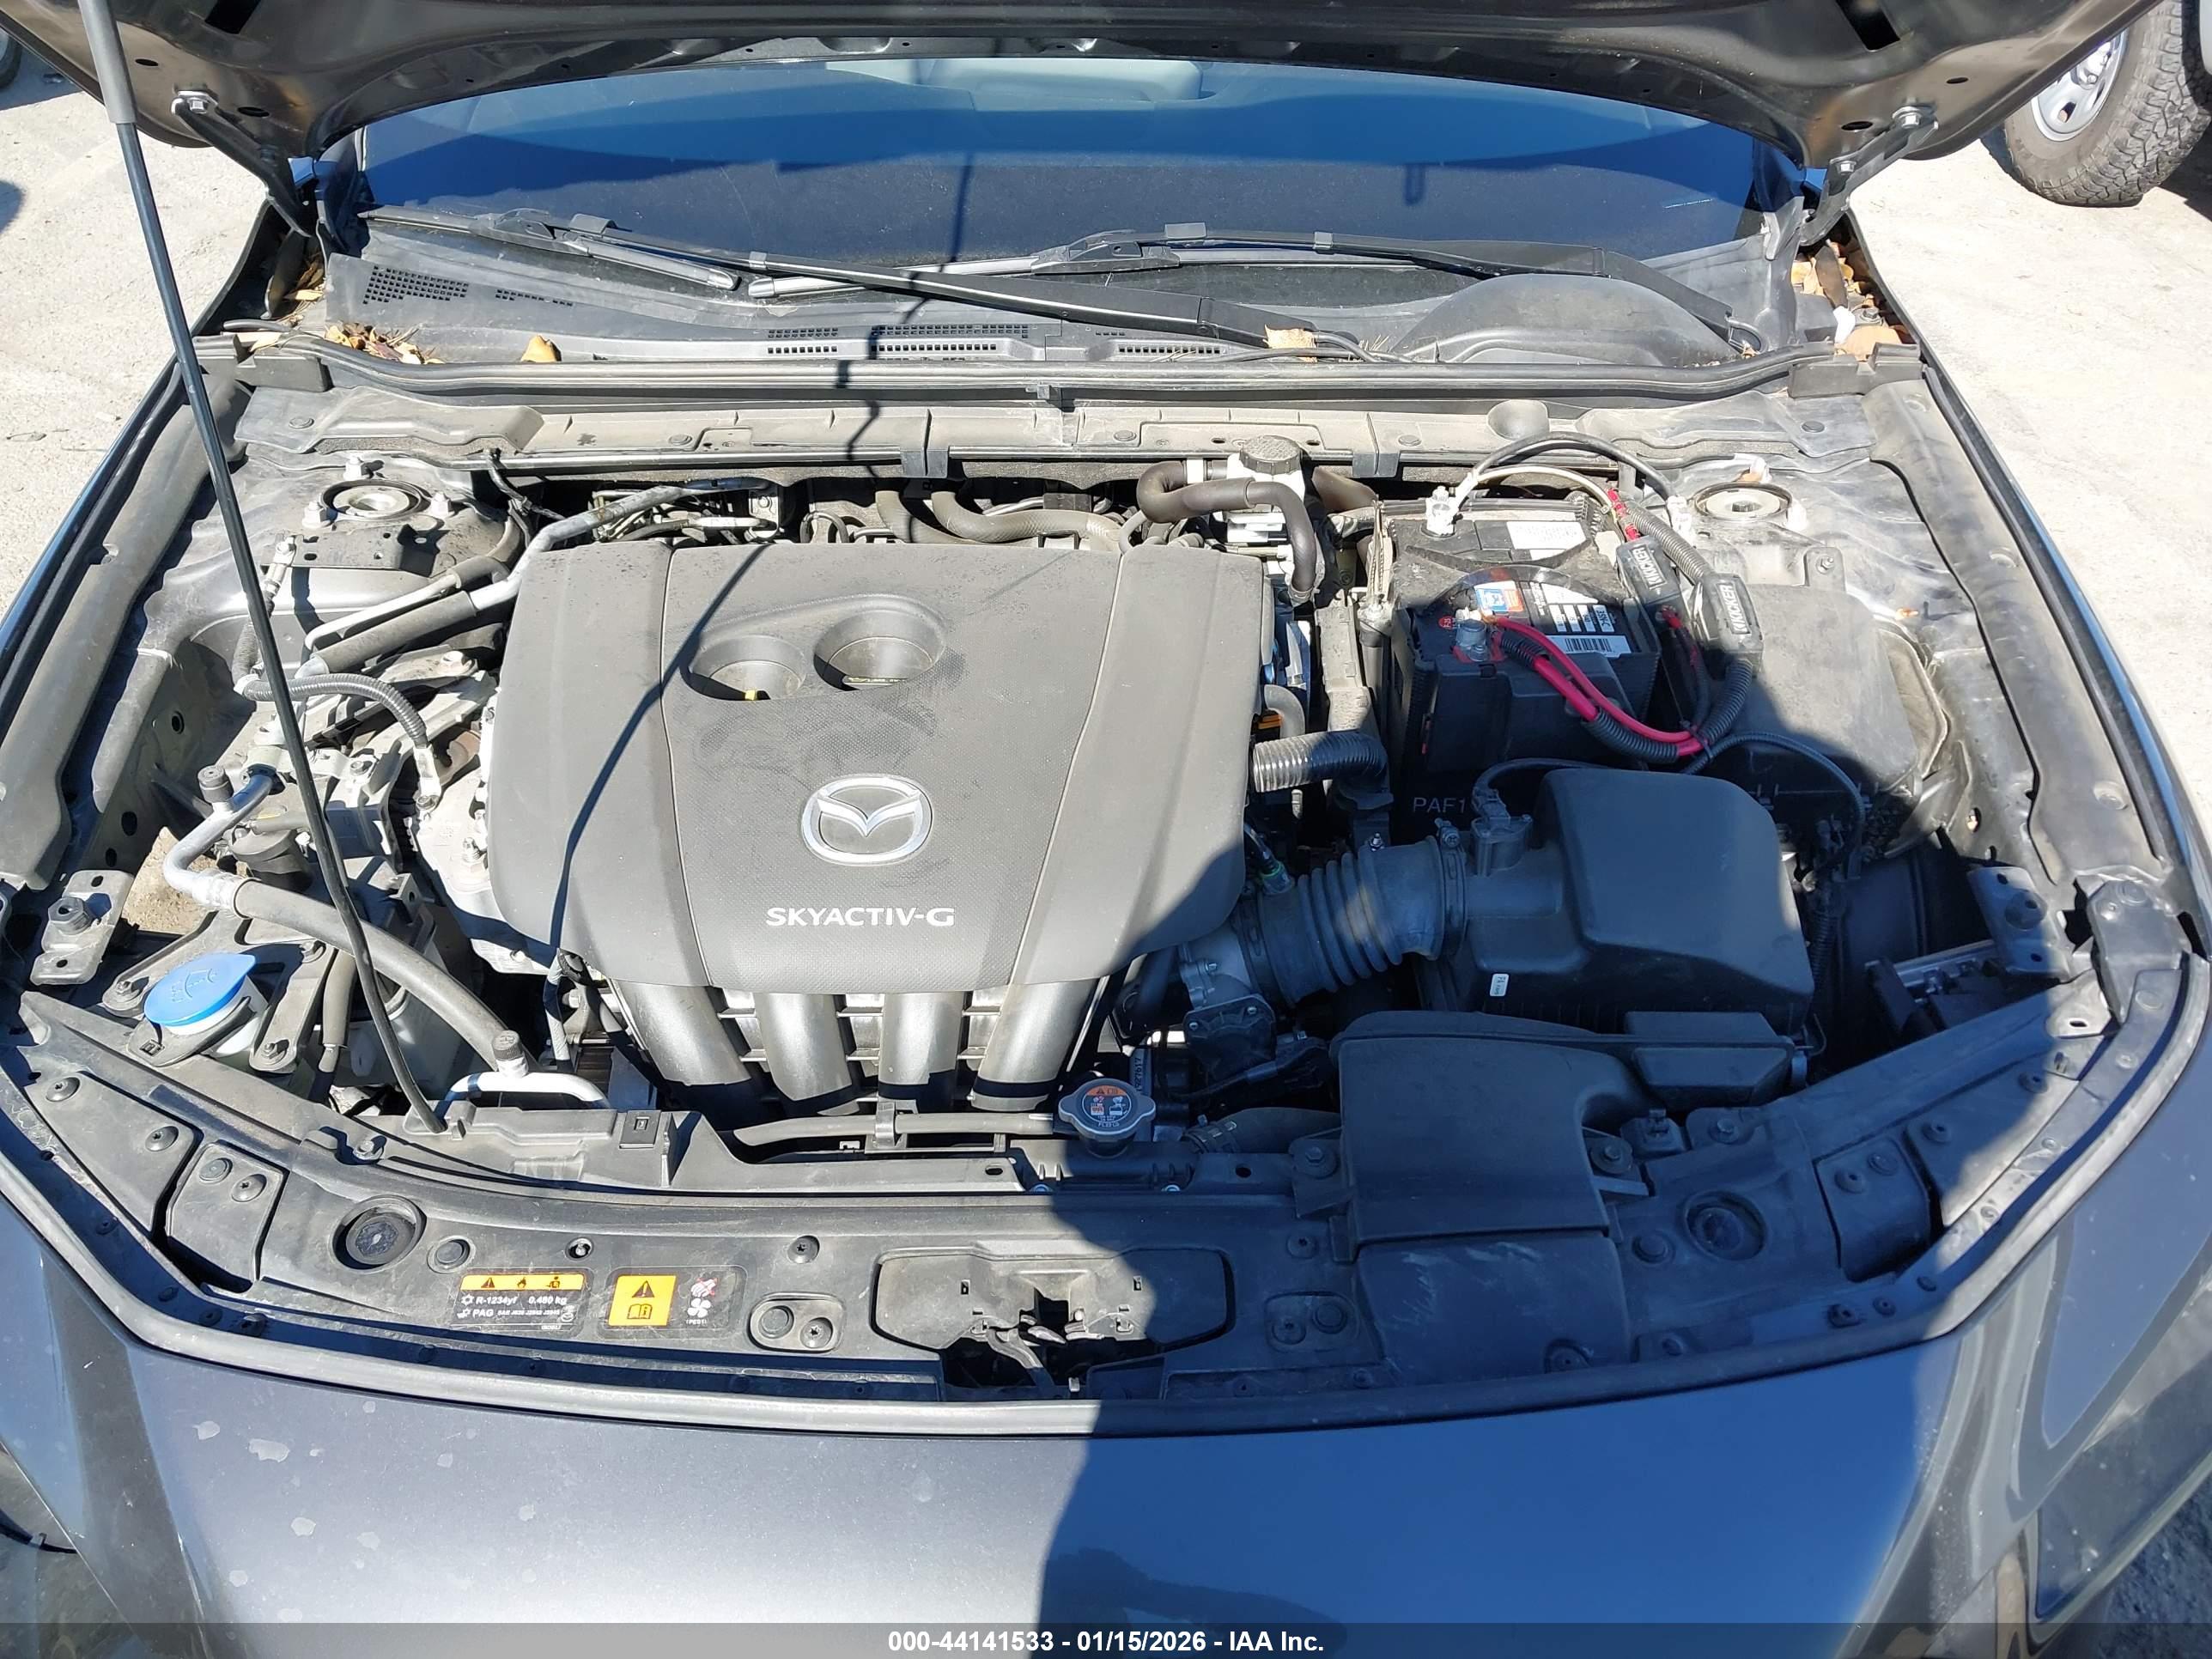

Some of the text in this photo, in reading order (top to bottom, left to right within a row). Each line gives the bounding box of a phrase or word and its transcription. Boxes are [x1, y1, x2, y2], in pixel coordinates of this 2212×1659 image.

[1631, 547, 1664, 586] KICKER
[1719, 582, 1748, 634] KICKER
[1413, 797, 1467, 813] PAF1
[765, 907, 956, 927] SKYACTIV-G
[475, 1296, 518, 1305] R-1234yf
[555, 1296, 568, 1306] kg
[472, 1309, 494, 1317] PAG
